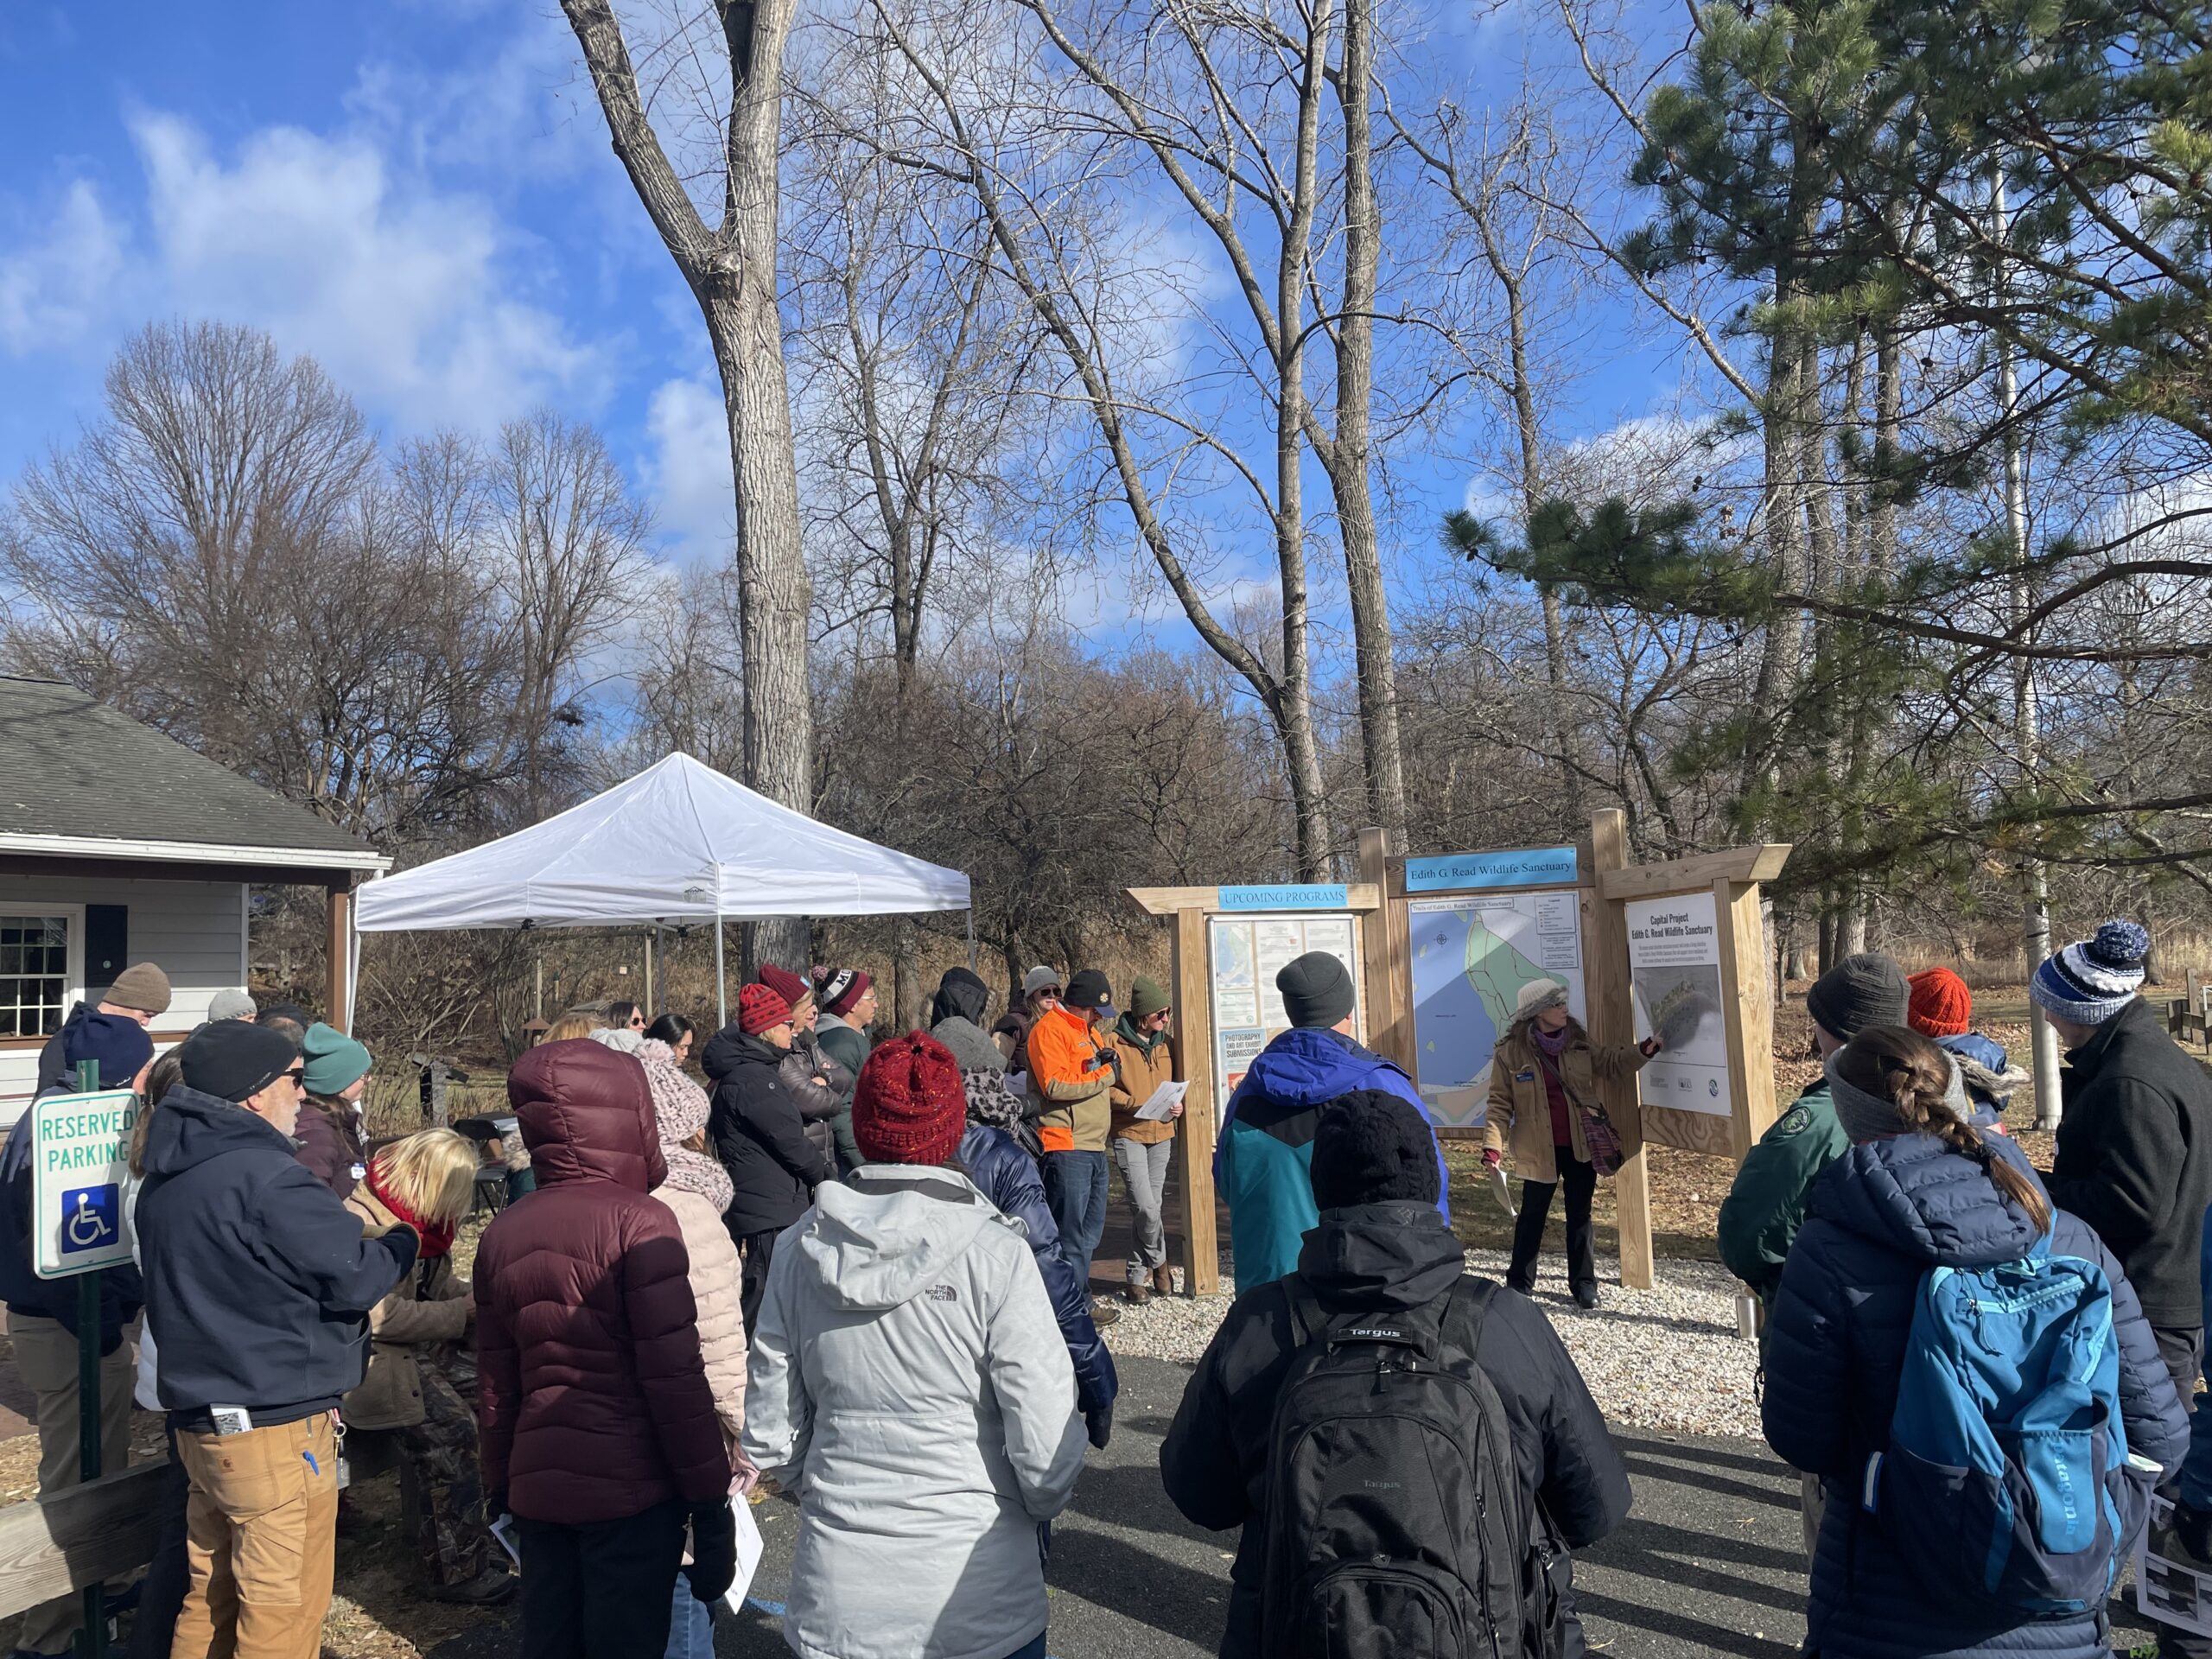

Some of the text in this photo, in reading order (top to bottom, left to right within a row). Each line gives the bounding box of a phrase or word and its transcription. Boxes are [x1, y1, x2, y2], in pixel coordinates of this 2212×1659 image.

[1411, 869, 1435, 880] Edith
[1452, 866, 1476, 877] Read
[1477, 864, 1519, 875] Wildlife
[1522, 862, 1571, 873] Sanctuary
[1224, 891, 1344, 904] UPCOMING PROGRAMS
[1650, 912, 1689, 926] Capital Project
[1631, 930, 1644, 939] Edith
[1651, 928, 1663, 938] Read
[1664, 926, 1684, 937] Wildlife
[1685, 925, 1713, 935] Sanctuary
[1224, 1033, 1261, 1042] PHOTOGRAPHY
[1226, 1048, 1262, 1058] SUBMISSIONS
[41, 1110, 134, 1141] RESERVED
[48, 1141, 130, 1172] PARKING
[1349, 1328, 1401, 1338] Targus
[1363, 1479, 1401, 1490] Targus
[2053, 1439, 2079, 1535] patagonia
